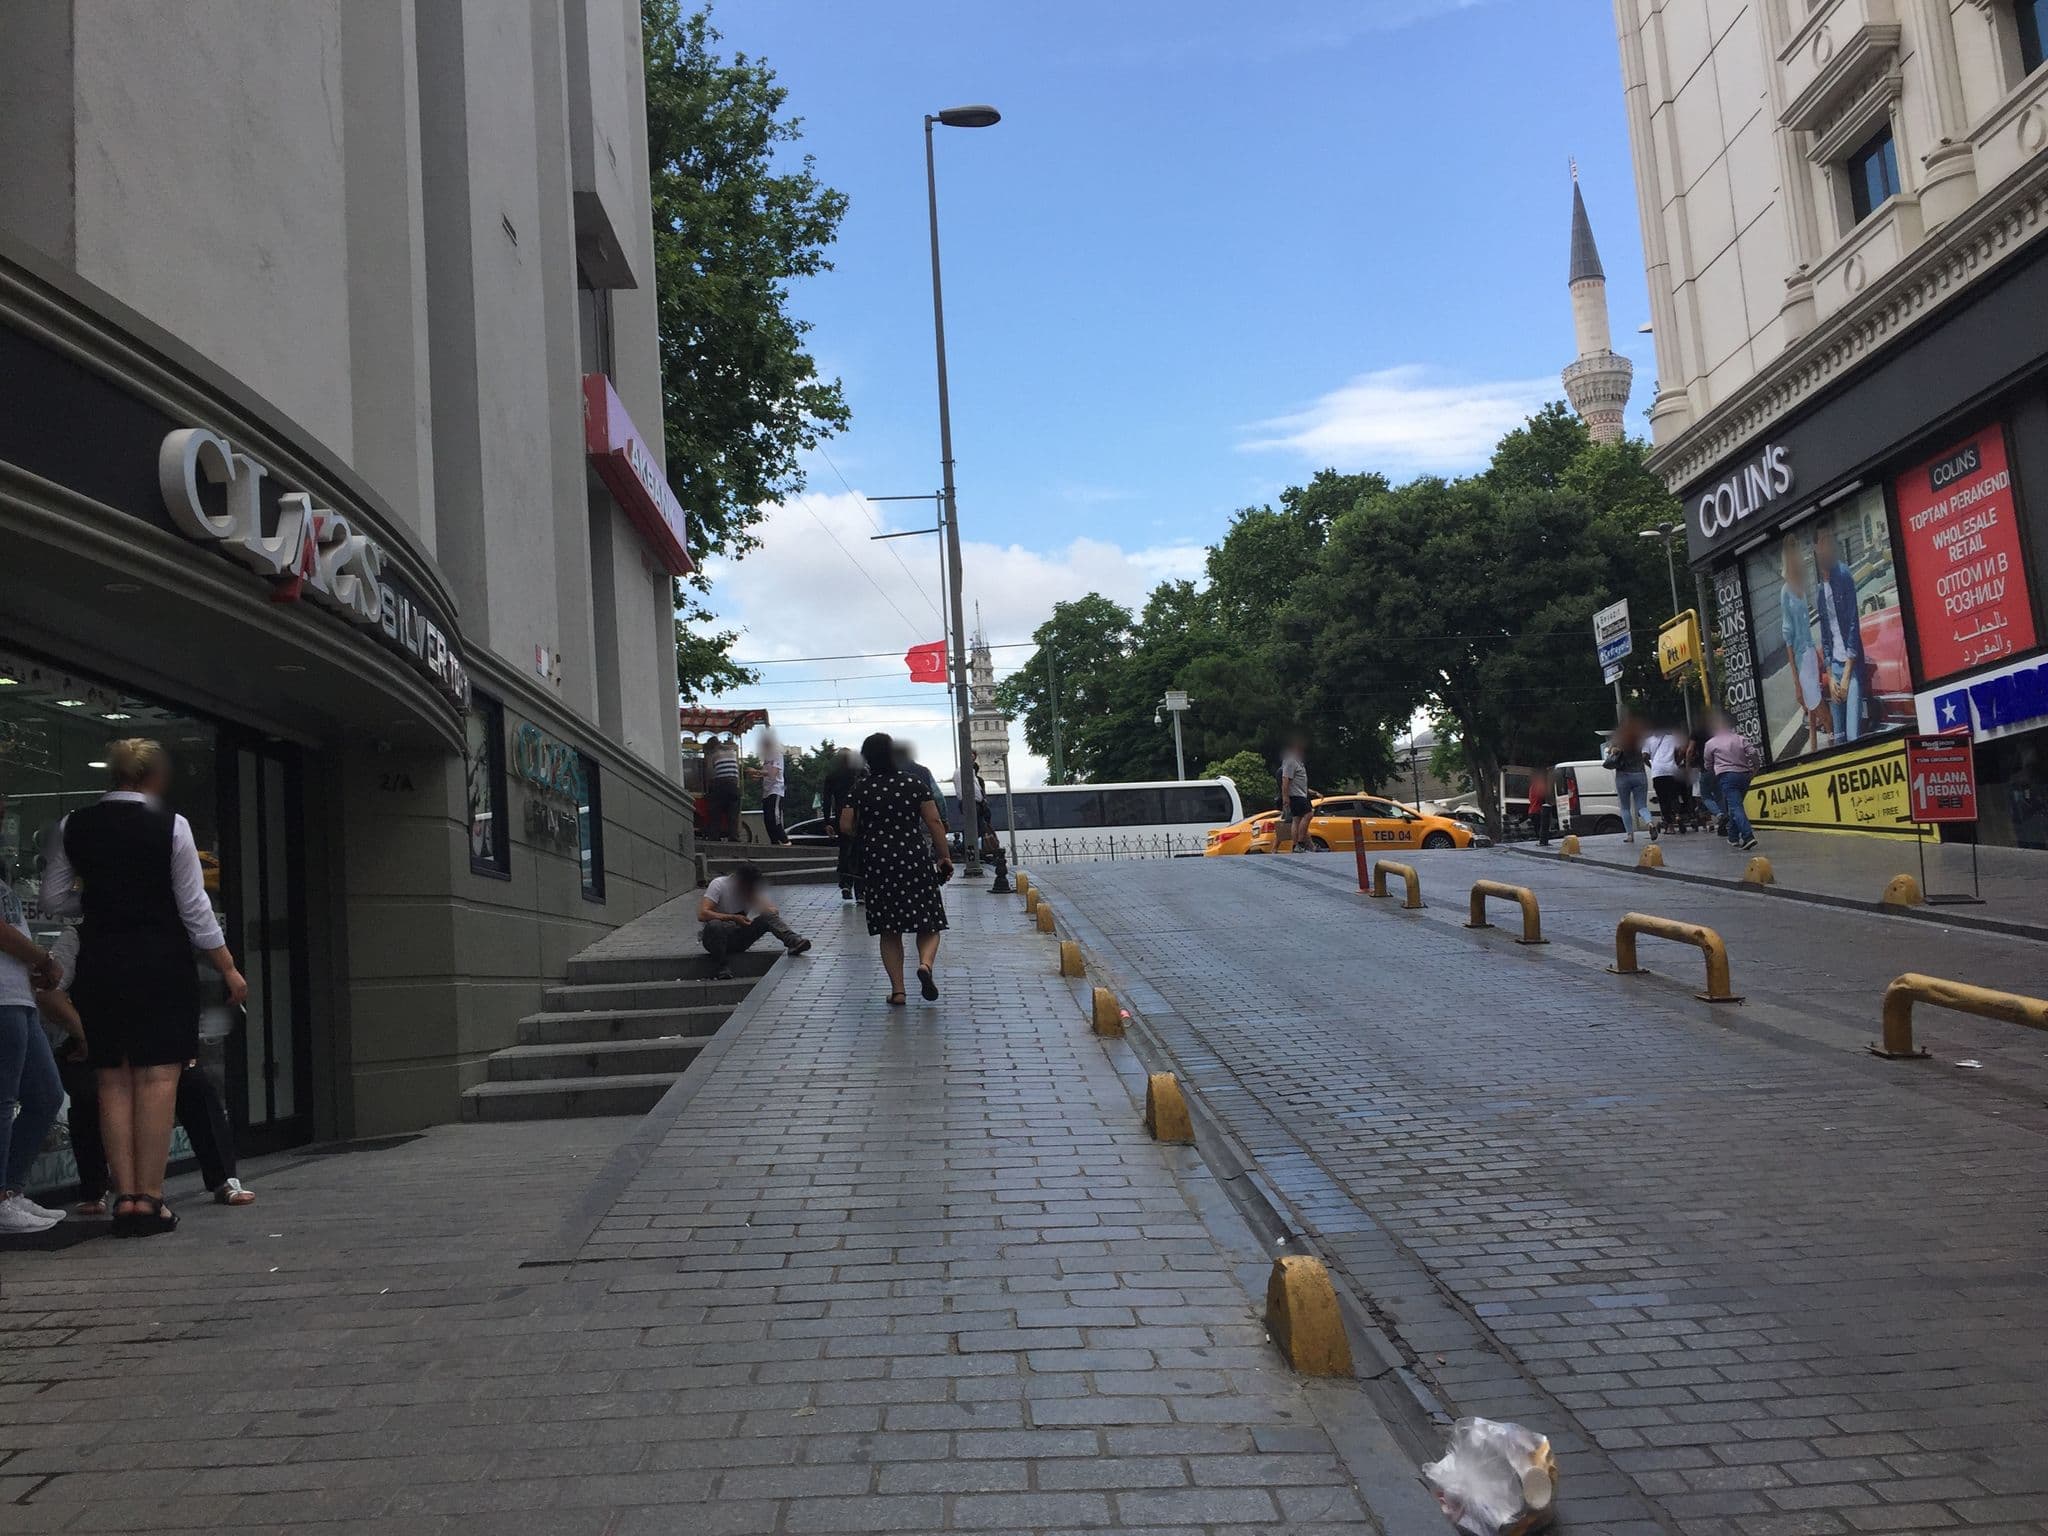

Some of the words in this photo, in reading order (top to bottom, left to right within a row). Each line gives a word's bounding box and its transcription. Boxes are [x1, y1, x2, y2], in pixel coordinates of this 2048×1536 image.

[1933, 449, 1977, 485] COLIN'S
[1699, 444, 1791, 538] COLIN'S
[1909, 501, 1949, 532] TOPTAN
[1932, 507, 1998, 550] WHOLESALE
[1948, 533, 1987, 563] RETAIL
[1936, 562, 1983, 598] ОПТОМ
[1984, 557, 1996, 578] И
[1997, 552, 2009, 573] В
[1945, 576, 2006, 617] РОЗНИЦУ
[380, 582, 448, 684] SILVER
[1827, 774, 1842, 823] 1
[1838, 760, 1906, 795] BEDAVA
[1913, 772, 1928, 810] 1
[1927, 784, 1972, 797] BEDAVA
[1929, 771, 1969, 784] ALANA
[1757, 789, 1770, 819] 2
[1770, 782, 1810, 806] ALANA
[1882, 806, 1899, 817] FREE
[1372, 830, 1395, 841] TED
[1398, 830, 1412, 841] 04
